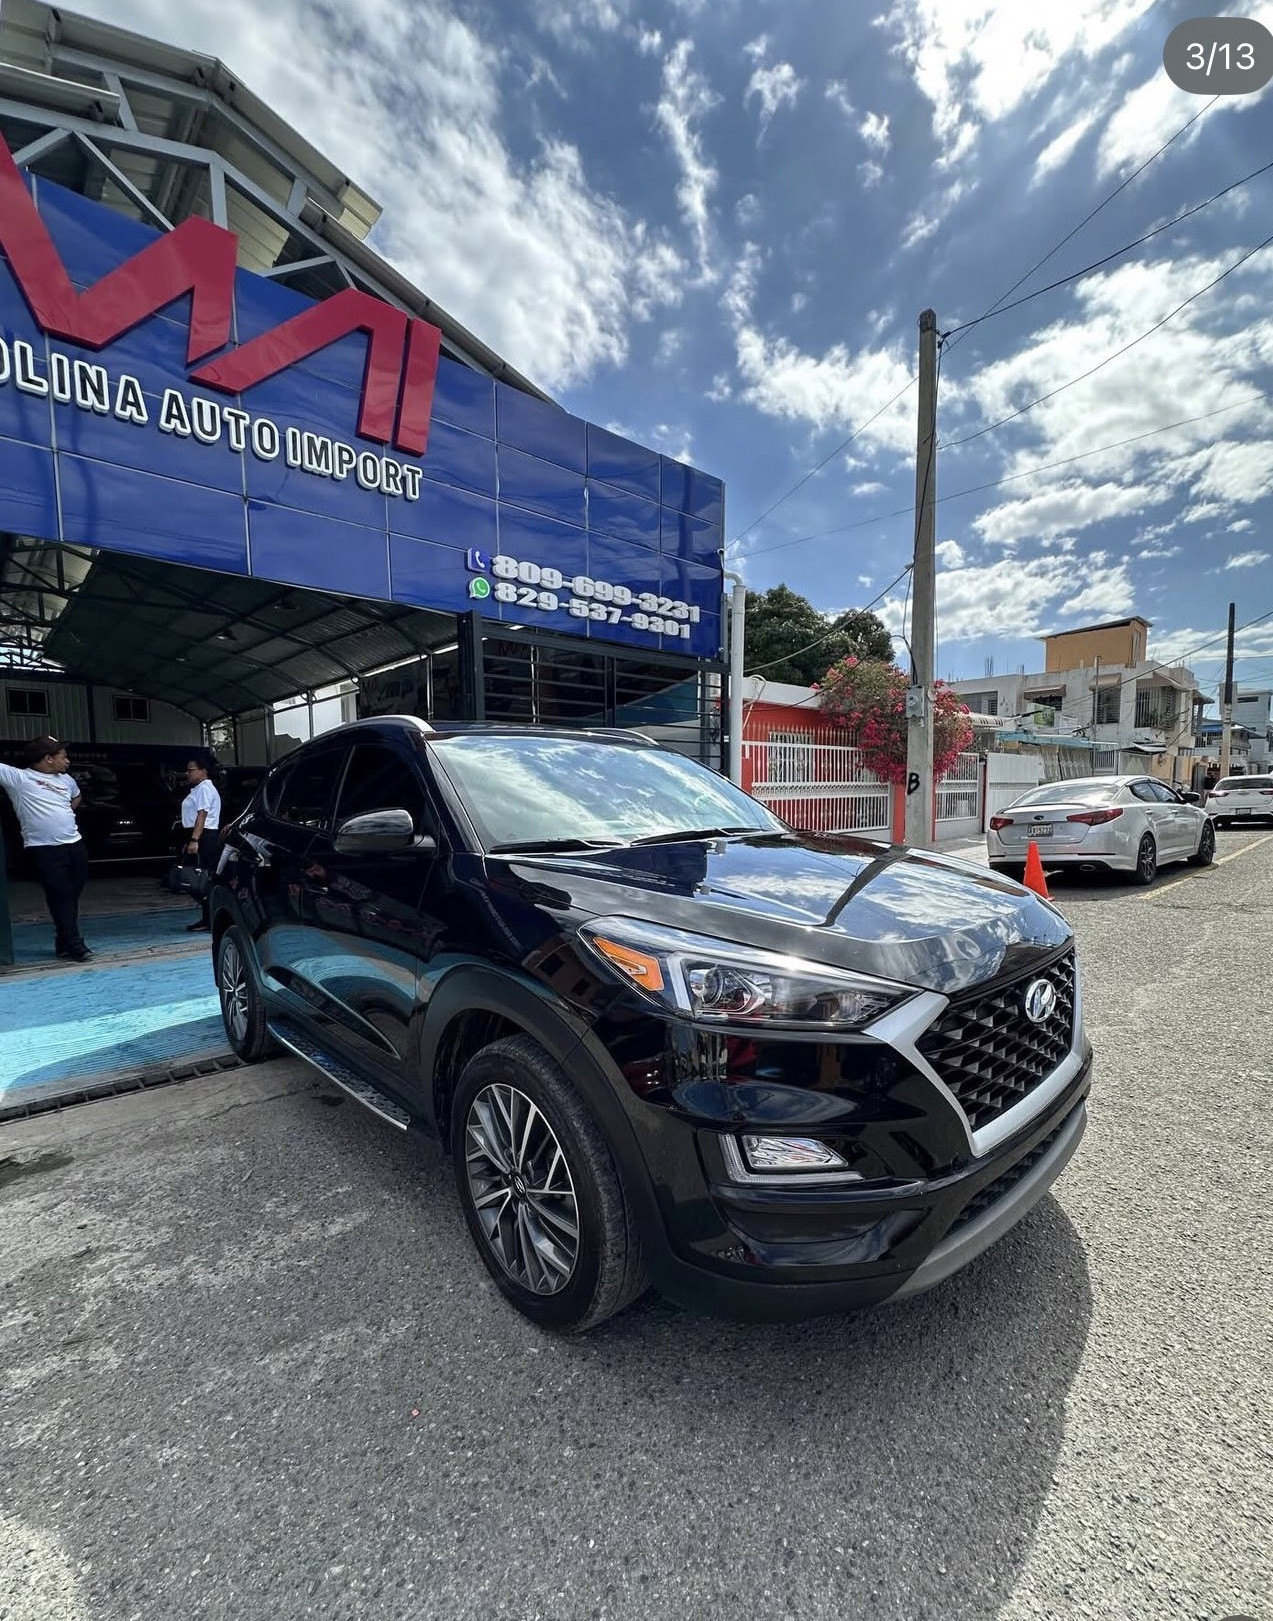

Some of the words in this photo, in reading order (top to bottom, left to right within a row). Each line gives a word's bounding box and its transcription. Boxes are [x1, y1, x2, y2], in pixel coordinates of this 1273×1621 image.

[159, 389, 280, 460] AUTO
[285, 427, 423, 500] IMPORT
[492, 555, 700, 623] 809-699-3231
[494, 582, 691, 639] 829-537-9301
[907, 773, 920, 795] B
